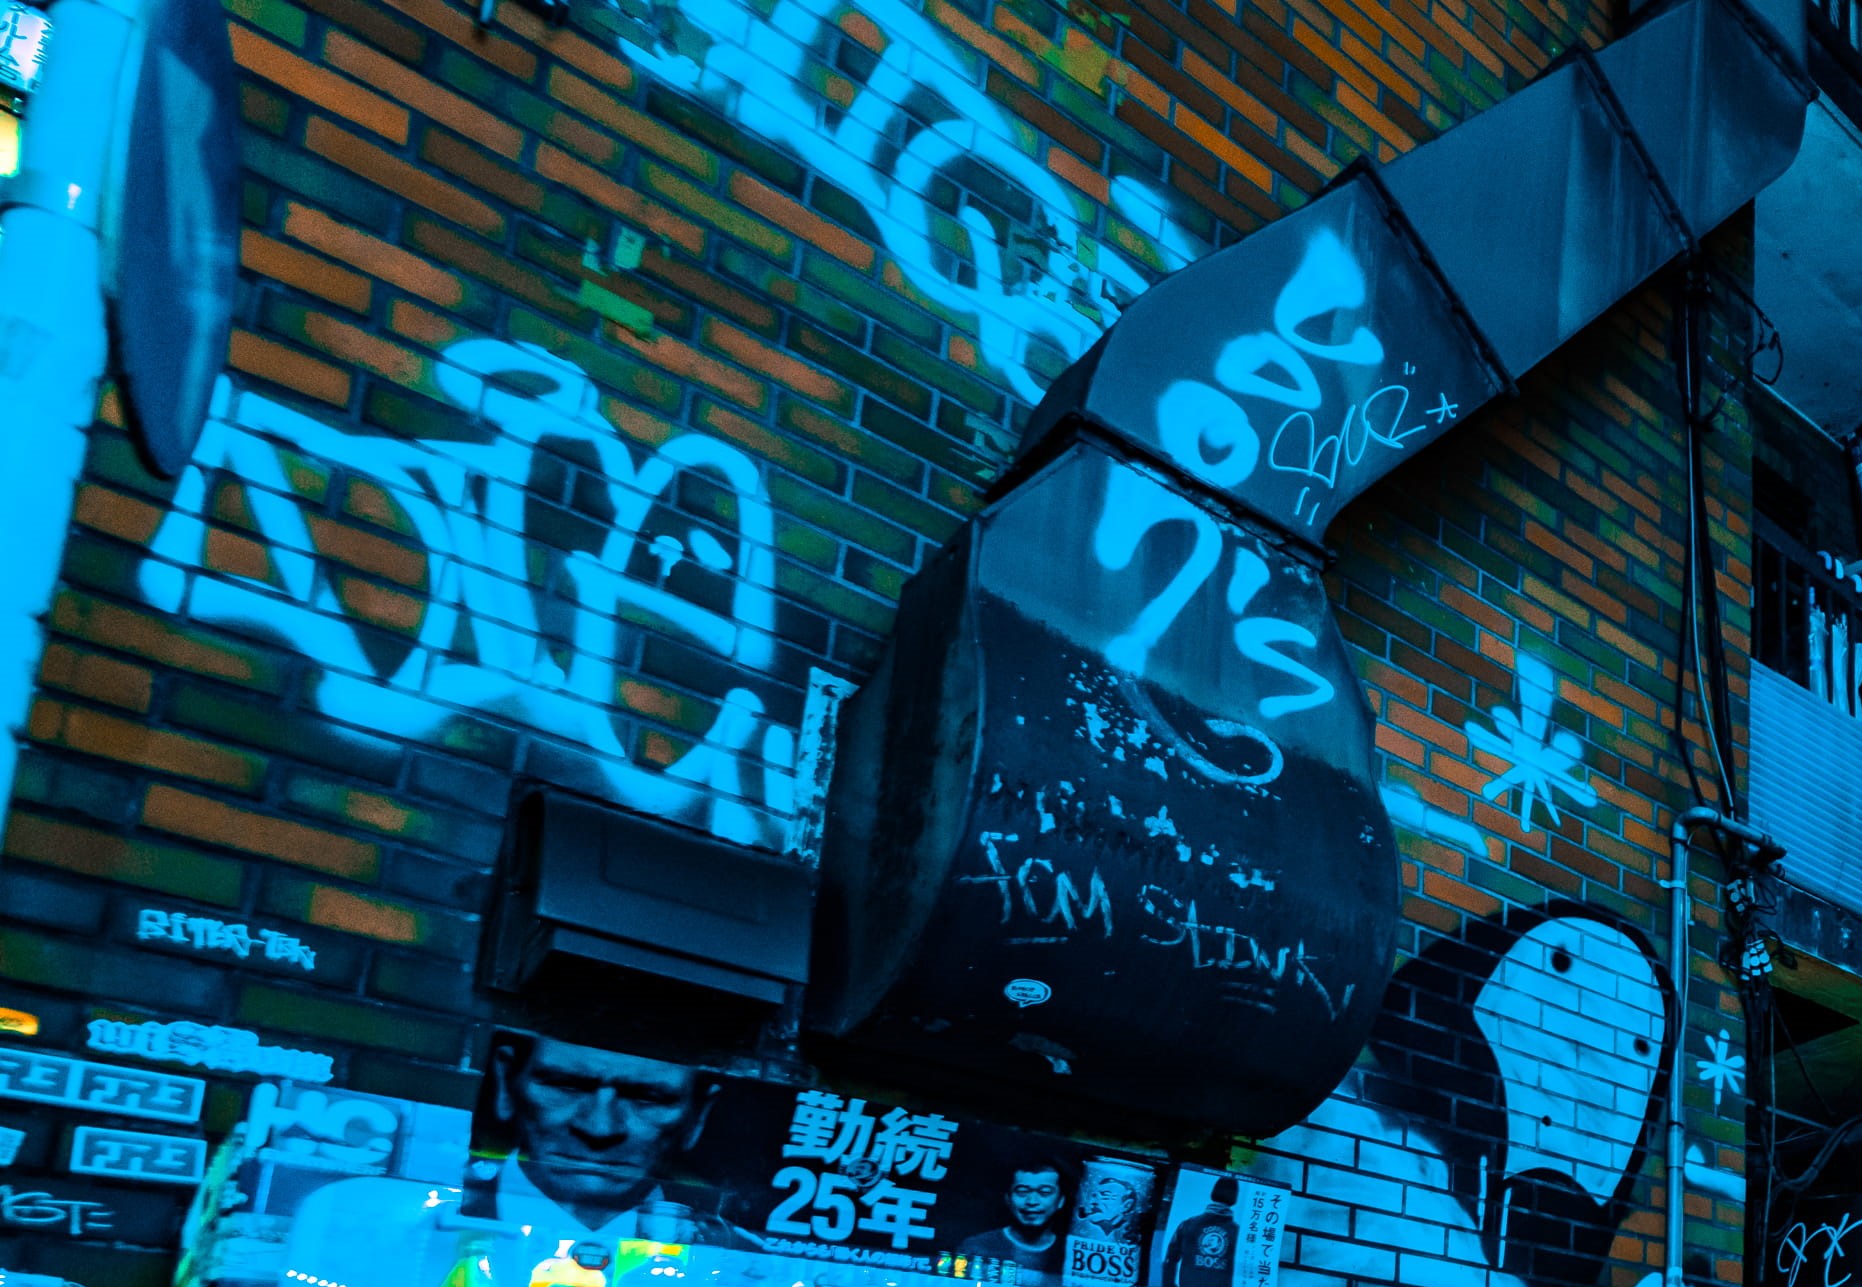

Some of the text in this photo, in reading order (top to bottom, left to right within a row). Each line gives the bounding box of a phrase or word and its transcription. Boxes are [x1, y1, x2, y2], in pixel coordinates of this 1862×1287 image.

[782, 1090, 959, 1182] 勤続
[766, 1165, 938, 1250] 25年
[1071, 1248, 1135, 1279] BOSS
[1073, 1239, 1115, 1255] PRIDE
